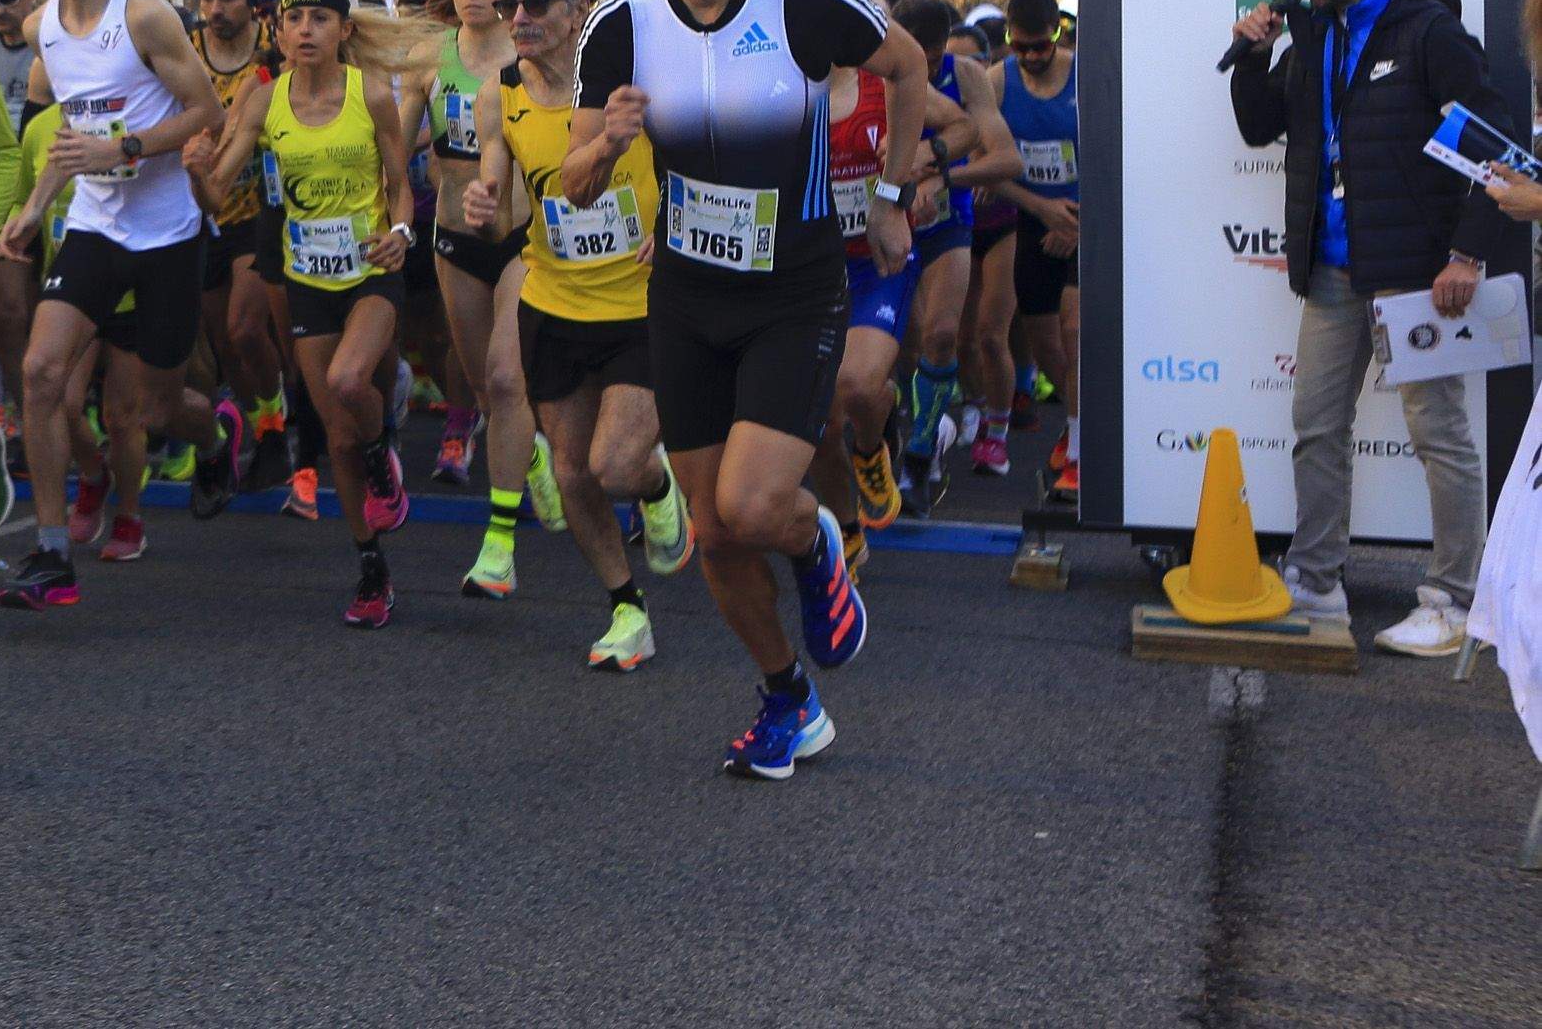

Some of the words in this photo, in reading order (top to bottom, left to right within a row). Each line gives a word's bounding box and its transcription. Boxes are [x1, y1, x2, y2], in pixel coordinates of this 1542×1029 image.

[733, 41, 779, 57] adidas
[1373, 60, 1395, 72] NIKE
[703, 193, 752, 210] MetLife
[314, 224, 350, 236] MetLife
[574, 231, 617, 256] 382
[688, 227, 744, 263] 1765
[307, 254, 355, 275] 3921
[1142, 356, 1220, 383] alsa
[1251, 375, 1293, 392] rafael
